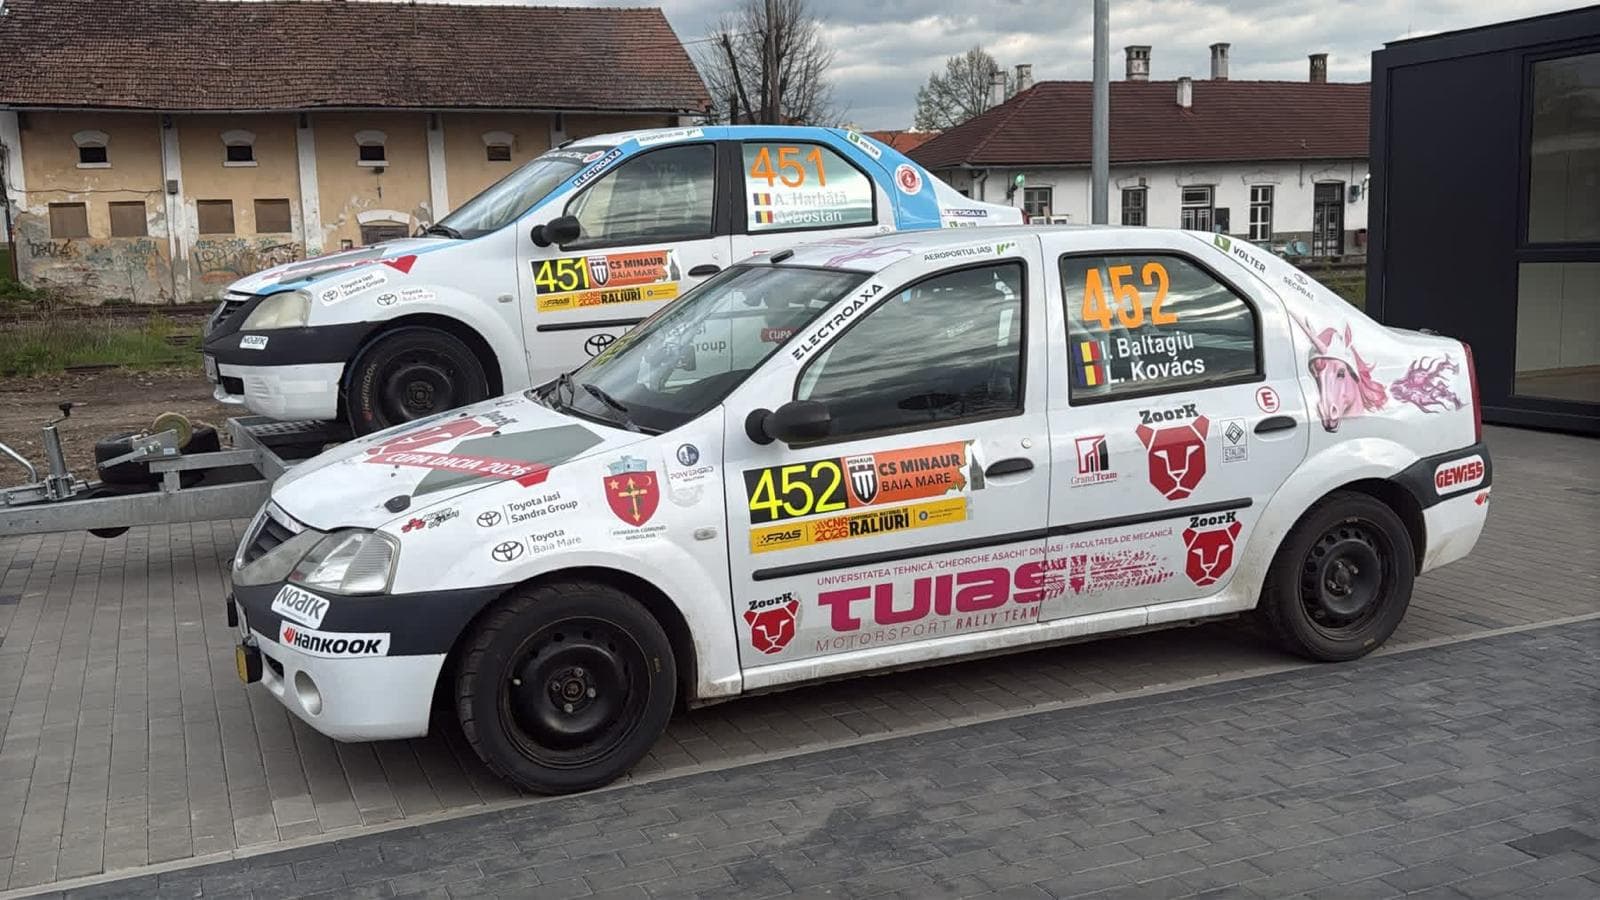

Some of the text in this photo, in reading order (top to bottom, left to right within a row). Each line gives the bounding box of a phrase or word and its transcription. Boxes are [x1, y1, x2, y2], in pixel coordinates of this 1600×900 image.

[574, 150, 622, 186] ELECTROAXA
[751, 146, 827, 188] 451
[774, 192, 789, 206] A.
[610, 257, 664, 270] CS MINAUR
[924, 247, 976, 261] AEROPORTUL
[1233, 246, 1266, 273] VOLTER
[341, 278, 362, 290] Toyota
[535, 257, 590, 292] 451
[611, 271, 632, 279] BAIA
[601, 290, 642, 305] RALIURI
[1081, 262, 1179, 331] 452
[792, 284, 883, 360] ELECTROAXA
[1101, 331, 1194, 360] I. Baltagiu
[1106, 356, 1206, 384] L. Kovács
[1261, 391, 1275, 407] E
[1139, 404, 1200, 424] ZoorK
[385, 452, 532, 477] CUPA DACIA 2026
[879, 453, 961, 475] CS MINAUR
[750, 461, 846, 519] 452
[882, 472, 951, 492] BAIA MARE
[509, 491, 561, 514] Toyota Iasi
[511, 500, 579, 524] Sandra Group
[826, 516, 849, 528] CNR
[849, 512, 910, 537] RALIURI
[1189, 511, 1237, 529] ZoorK
[531, 528, 565, 543] Toyota
[533, 535, 582, 553] Baia Mare
[766, 529, 801, 543] FRAS
[815, 526, 849, 542] 2026
[817, 567, 892, 586] UNIVERSITATEA
[1030, 546, 1045, 555] DIN
[1070, 537, 1119, 550] FACULTATEA
[1120, 535, 1132, 544] DE
[749, 592, 793, 611] ZoorK
[816, 606, 1038, 652] MOTORSPORT RALLY TEAM
